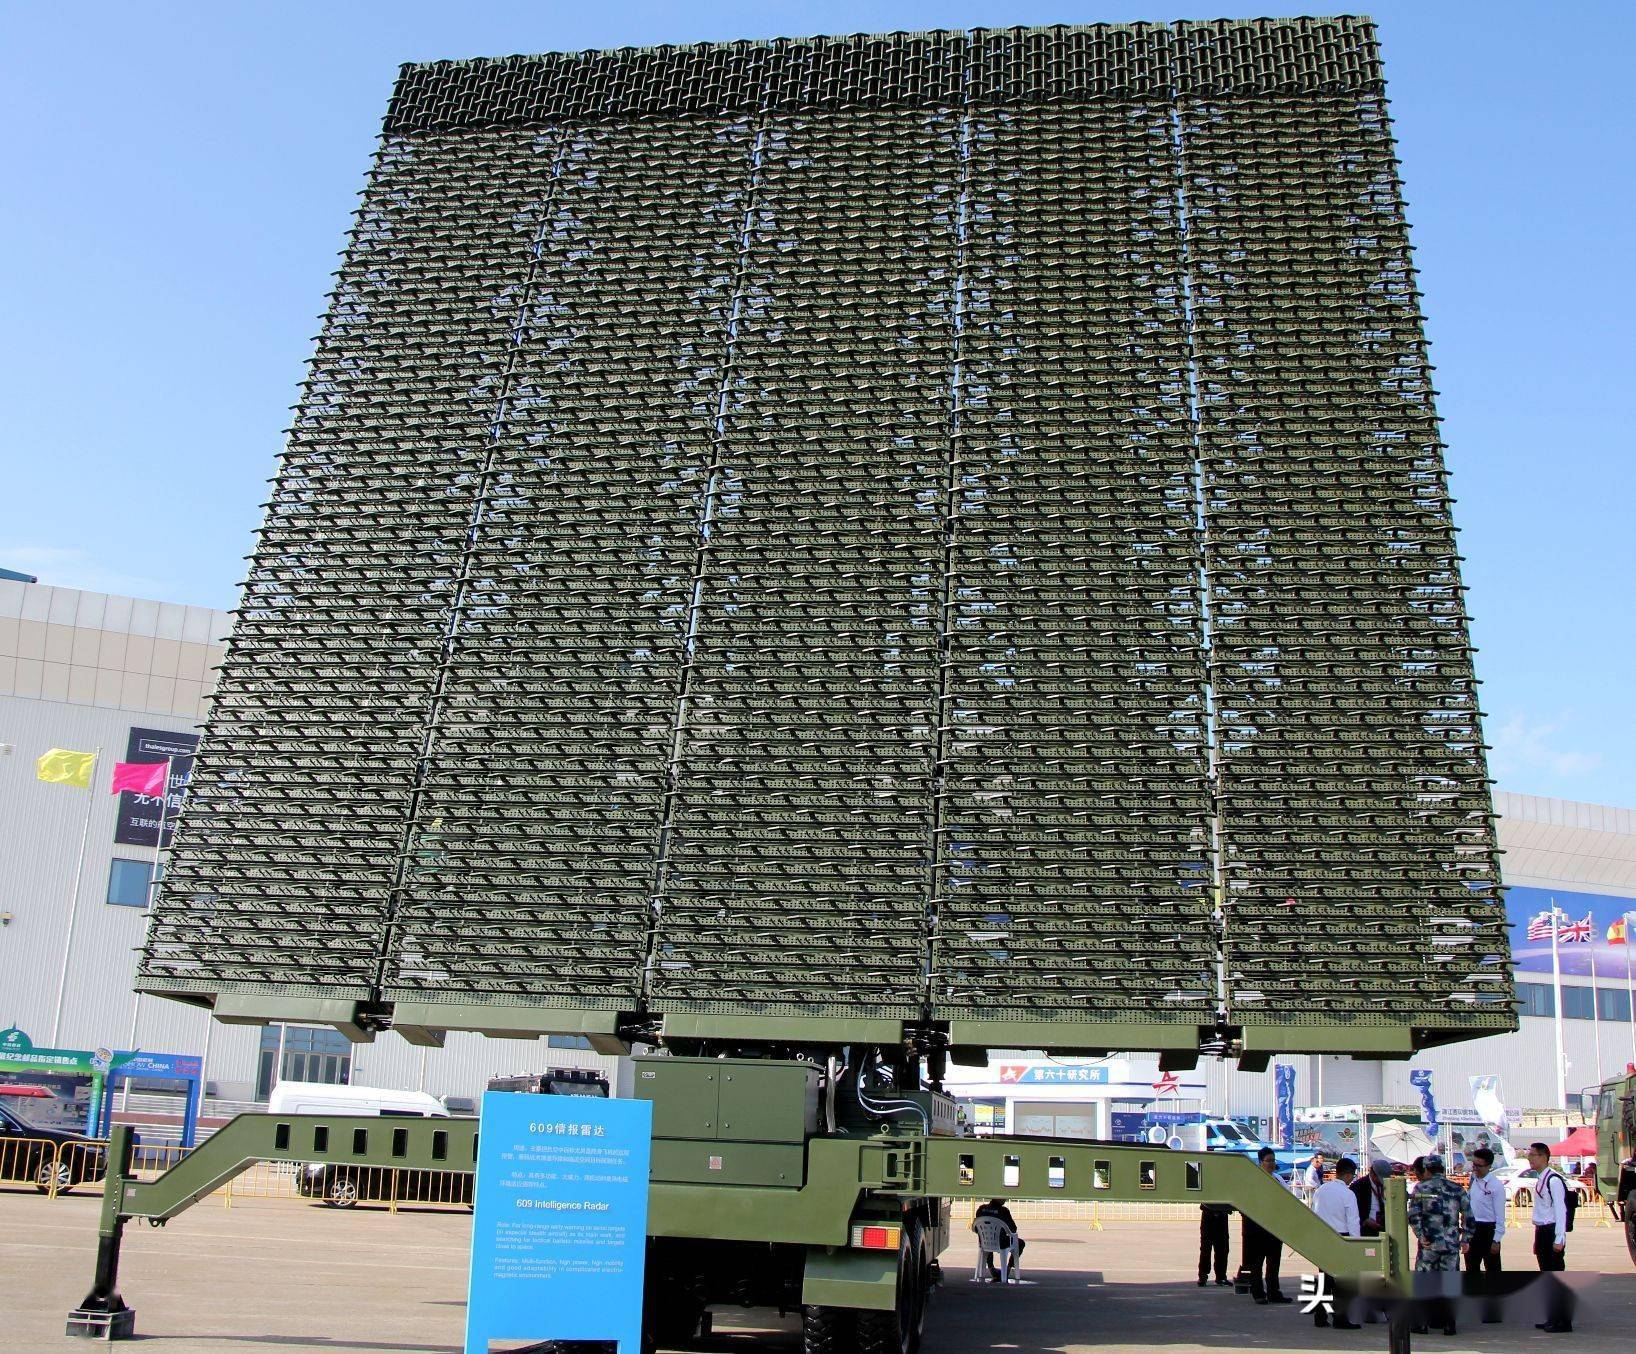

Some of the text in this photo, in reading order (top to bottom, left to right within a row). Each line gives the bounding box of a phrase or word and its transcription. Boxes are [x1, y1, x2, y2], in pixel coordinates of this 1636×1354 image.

[145, 743, 191, 754] thalesgroup.com
[147, 1062, 170, 1070] CHINA
[1034, 1069, 1101, 1081] 第六十研究所
[529, 1122, 605, 1137] 609情报雷达
[516, 1199, 609, 1211] 609 Intelligence Radar
